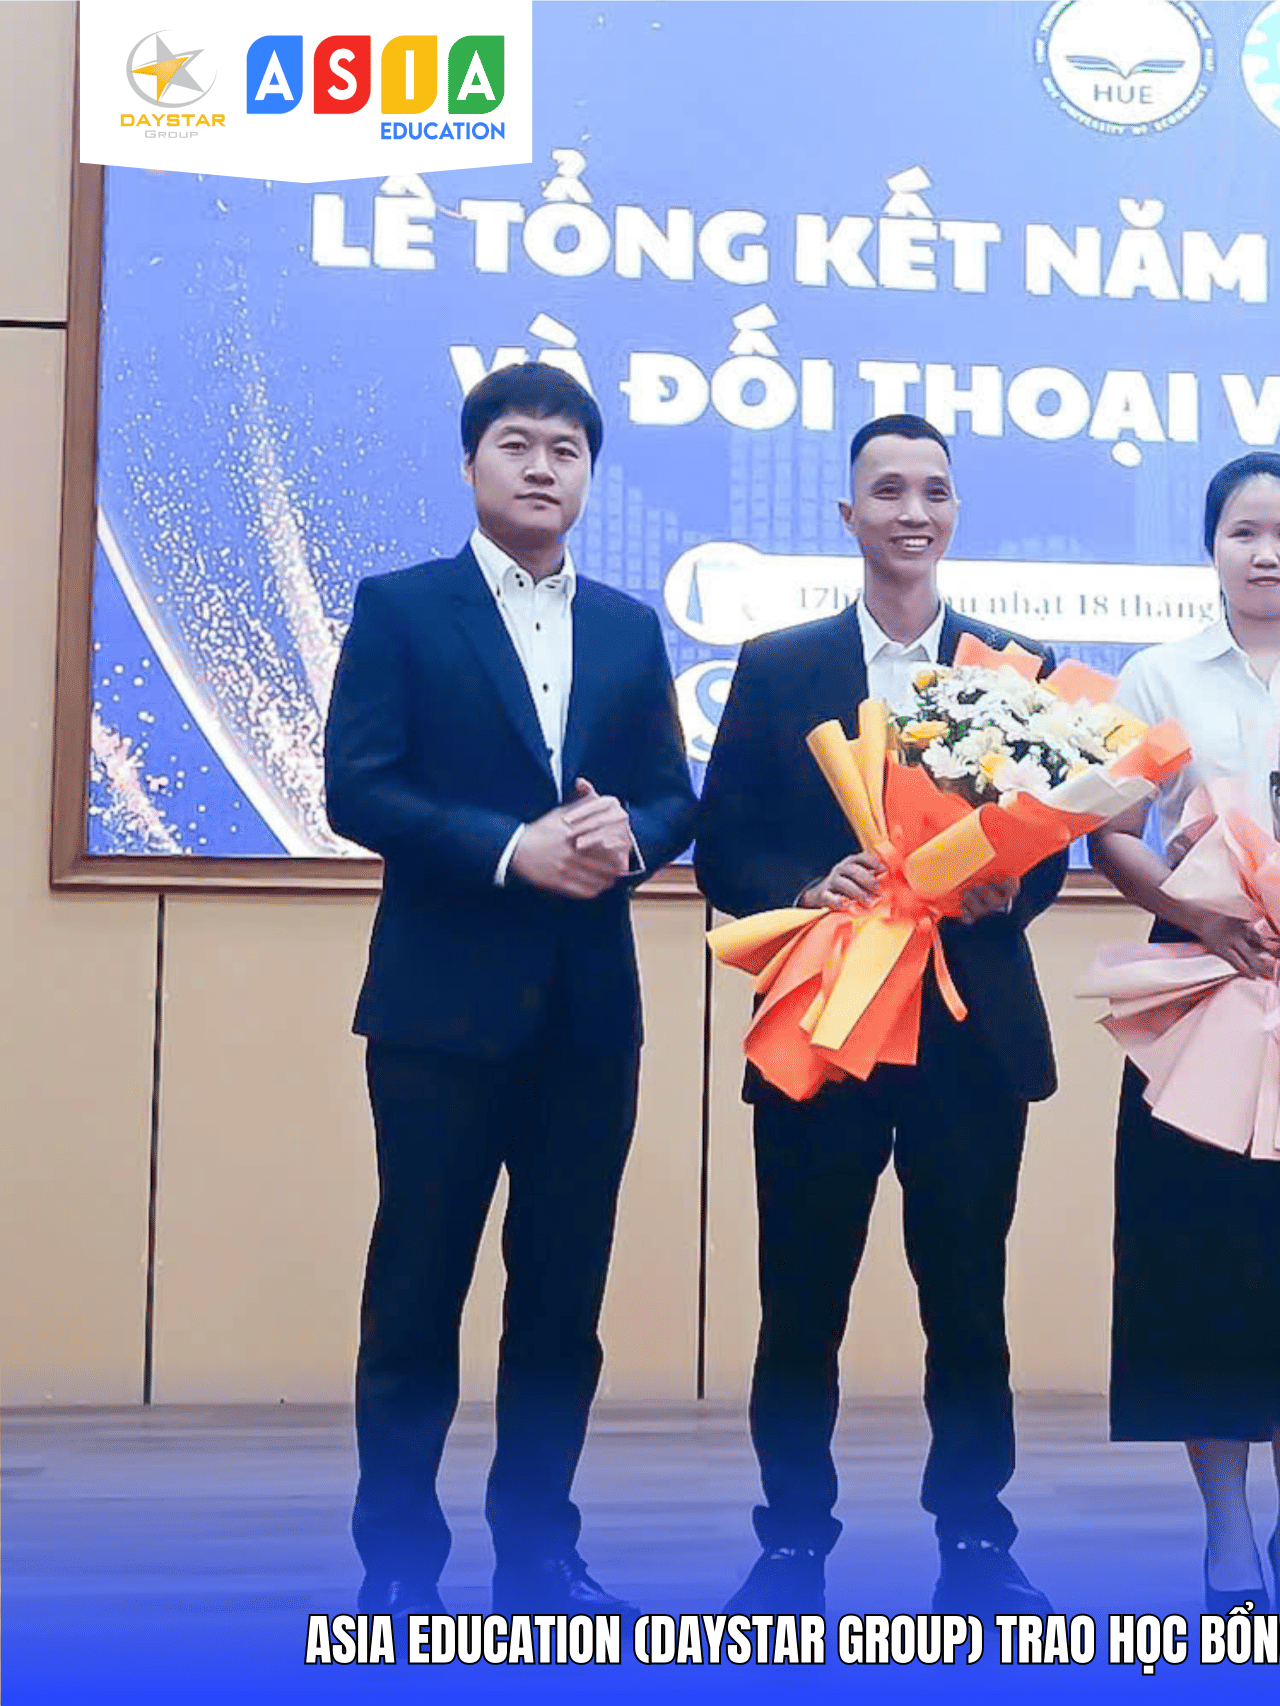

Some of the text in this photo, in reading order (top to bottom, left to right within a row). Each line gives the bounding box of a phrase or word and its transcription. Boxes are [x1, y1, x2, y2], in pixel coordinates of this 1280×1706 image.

[1093, 83, 1154, 104] HUE
[460, 146, 770, 286] TỔNG
[795, 164, 1002, 293] KẾT
[1024, 197, 1268, 304] NĂM
[618, 302, 836, 432] ĐỐI
[857, 359, 1197, 468] THOẠI
[1080, 595, 1108, 615] 18
